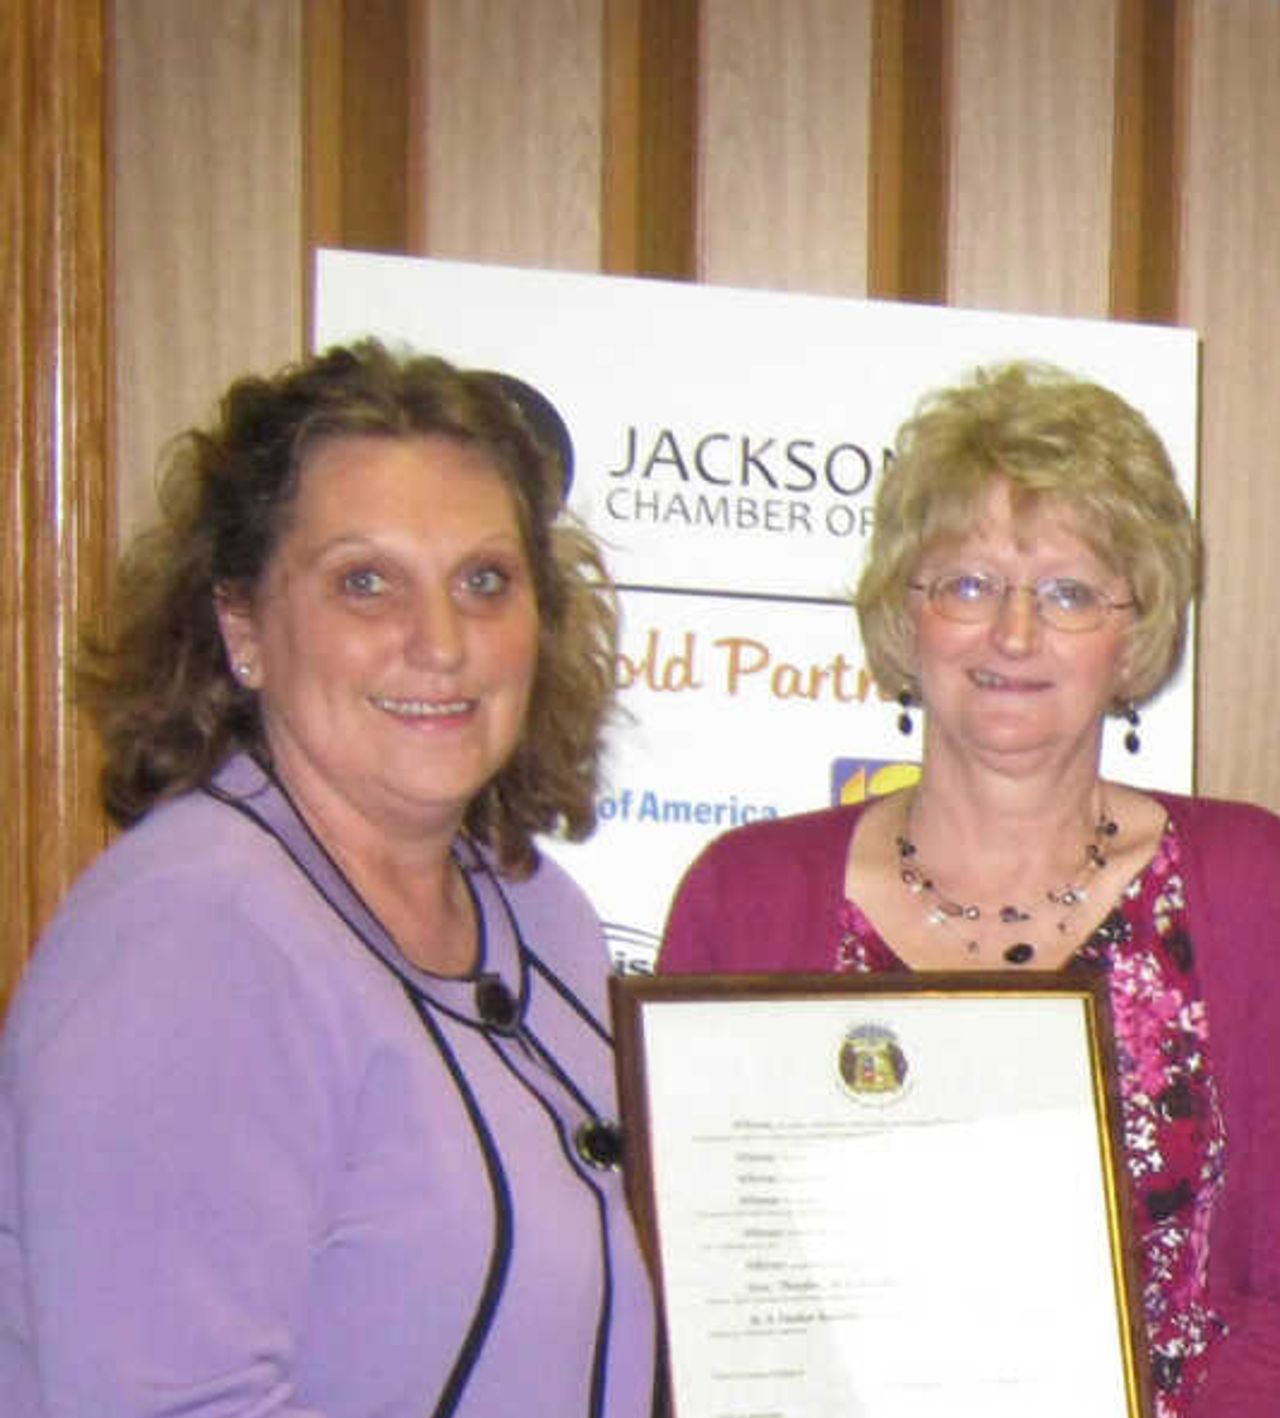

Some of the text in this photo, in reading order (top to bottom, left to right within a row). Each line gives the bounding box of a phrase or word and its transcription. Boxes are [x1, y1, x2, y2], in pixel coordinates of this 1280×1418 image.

[606, 486, 812, 534] CHAMBER
[614, 628, 703, 692] old
[639, 789, 779, 826] America
